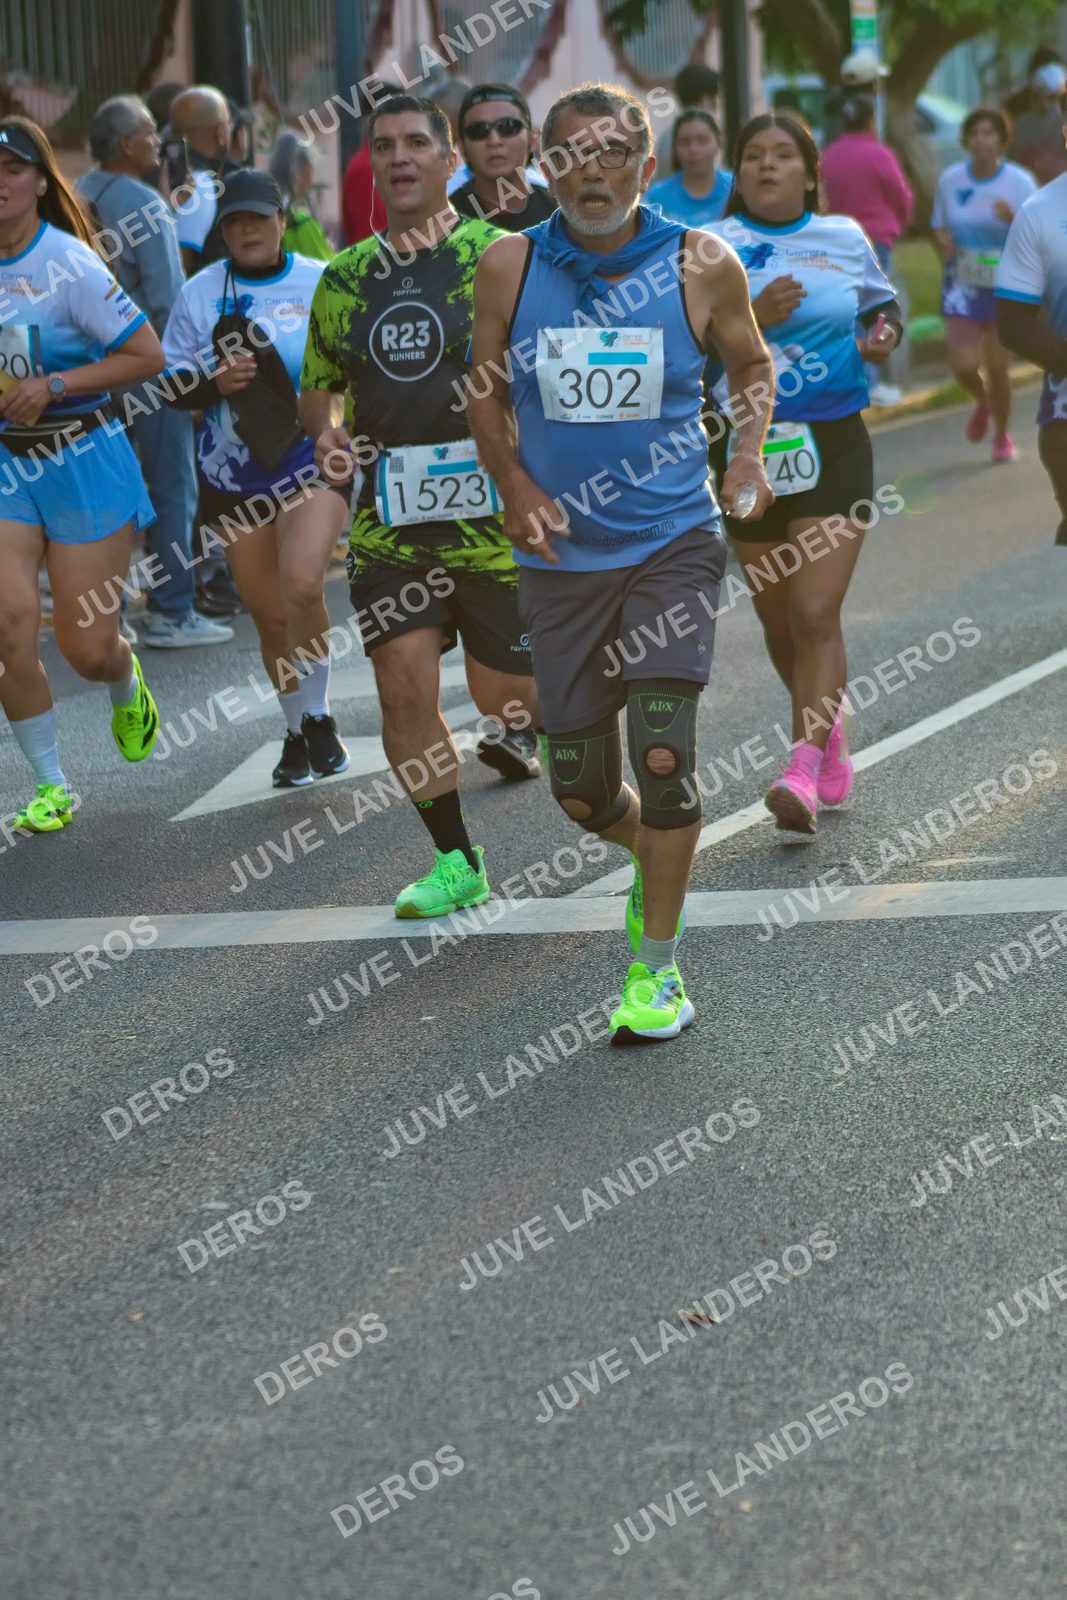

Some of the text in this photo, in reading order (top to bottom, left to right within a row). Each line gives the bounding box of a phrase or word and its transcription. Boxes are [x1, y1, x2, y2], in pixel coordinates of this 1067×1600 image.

[381, 320, 431, 350] R23
[389, 351, 425, 362] RUNNERS
[558, 368, 641, 409] 302
[393, 473, 486, 514] 1523
